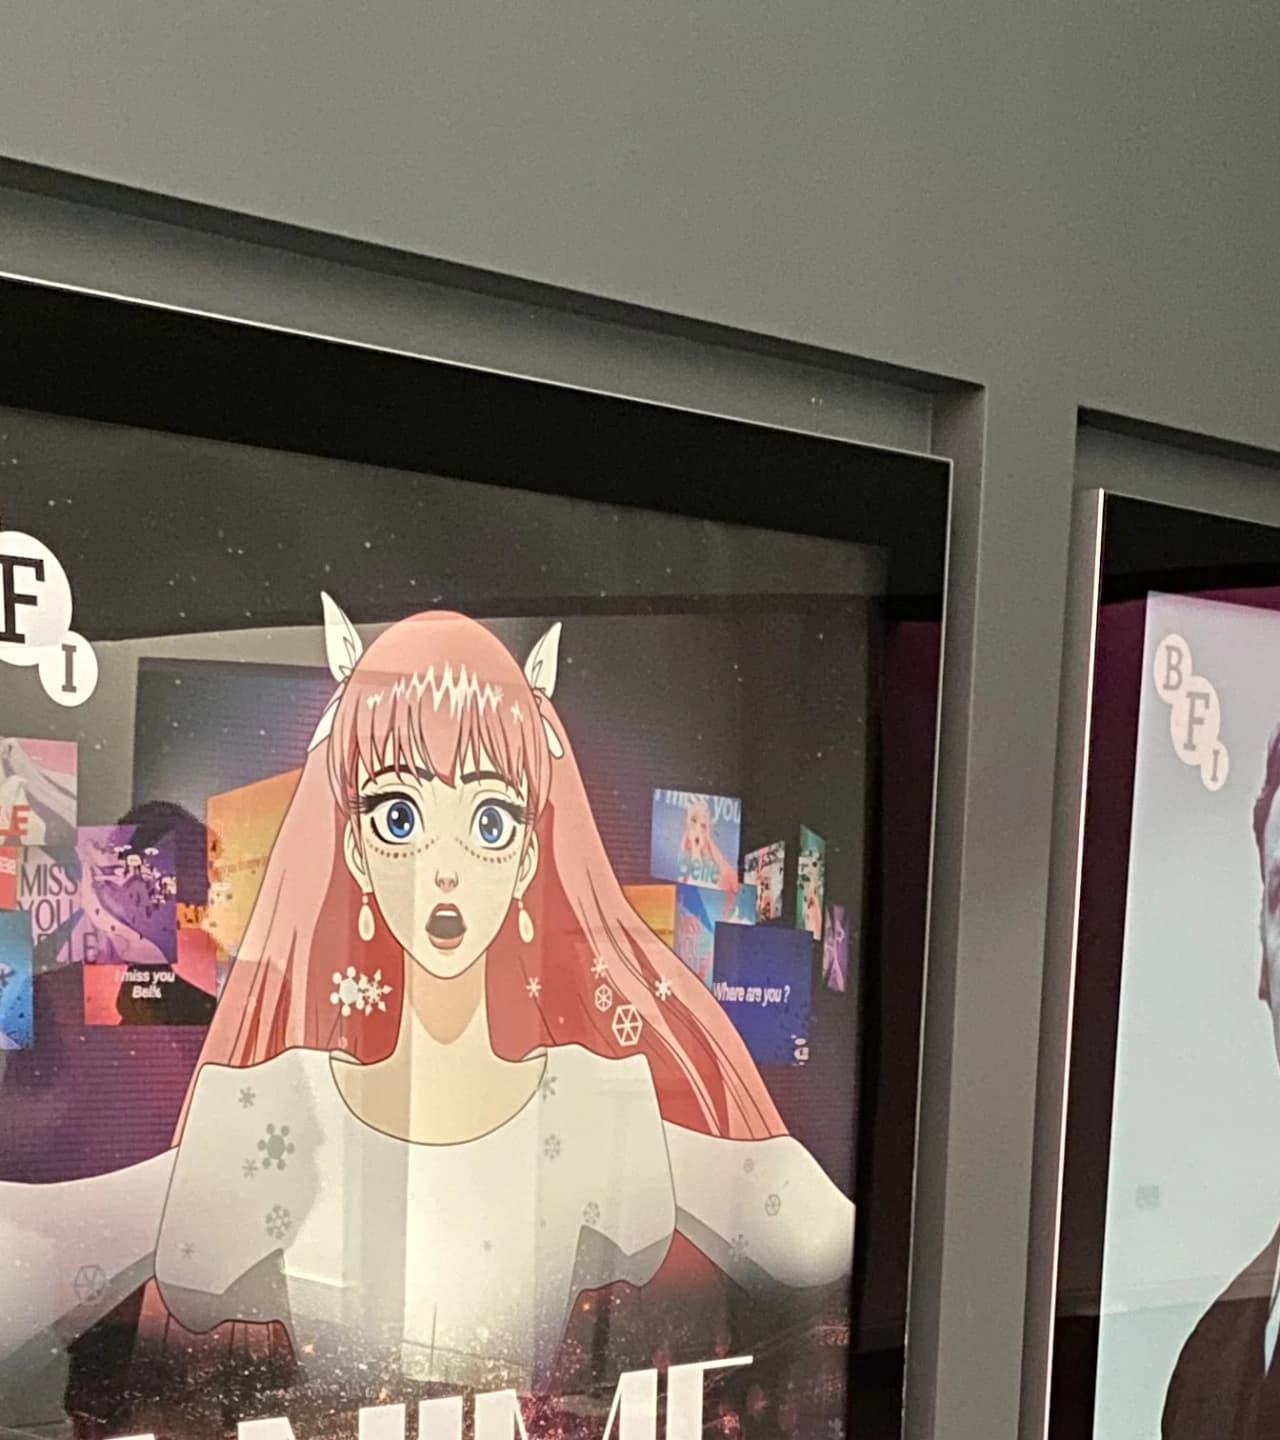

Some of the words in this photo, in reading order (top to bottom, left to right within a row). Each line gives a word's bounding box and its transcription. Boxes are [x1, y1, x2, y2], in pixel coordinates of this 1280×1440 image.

[1162, 645, 1220, 782] BFI
[20, 864, 78, 897] MISS
[152, 971, 176, 985] you
[745, 987, 762, 1002] are
[762, 987, 782, 1007] you
